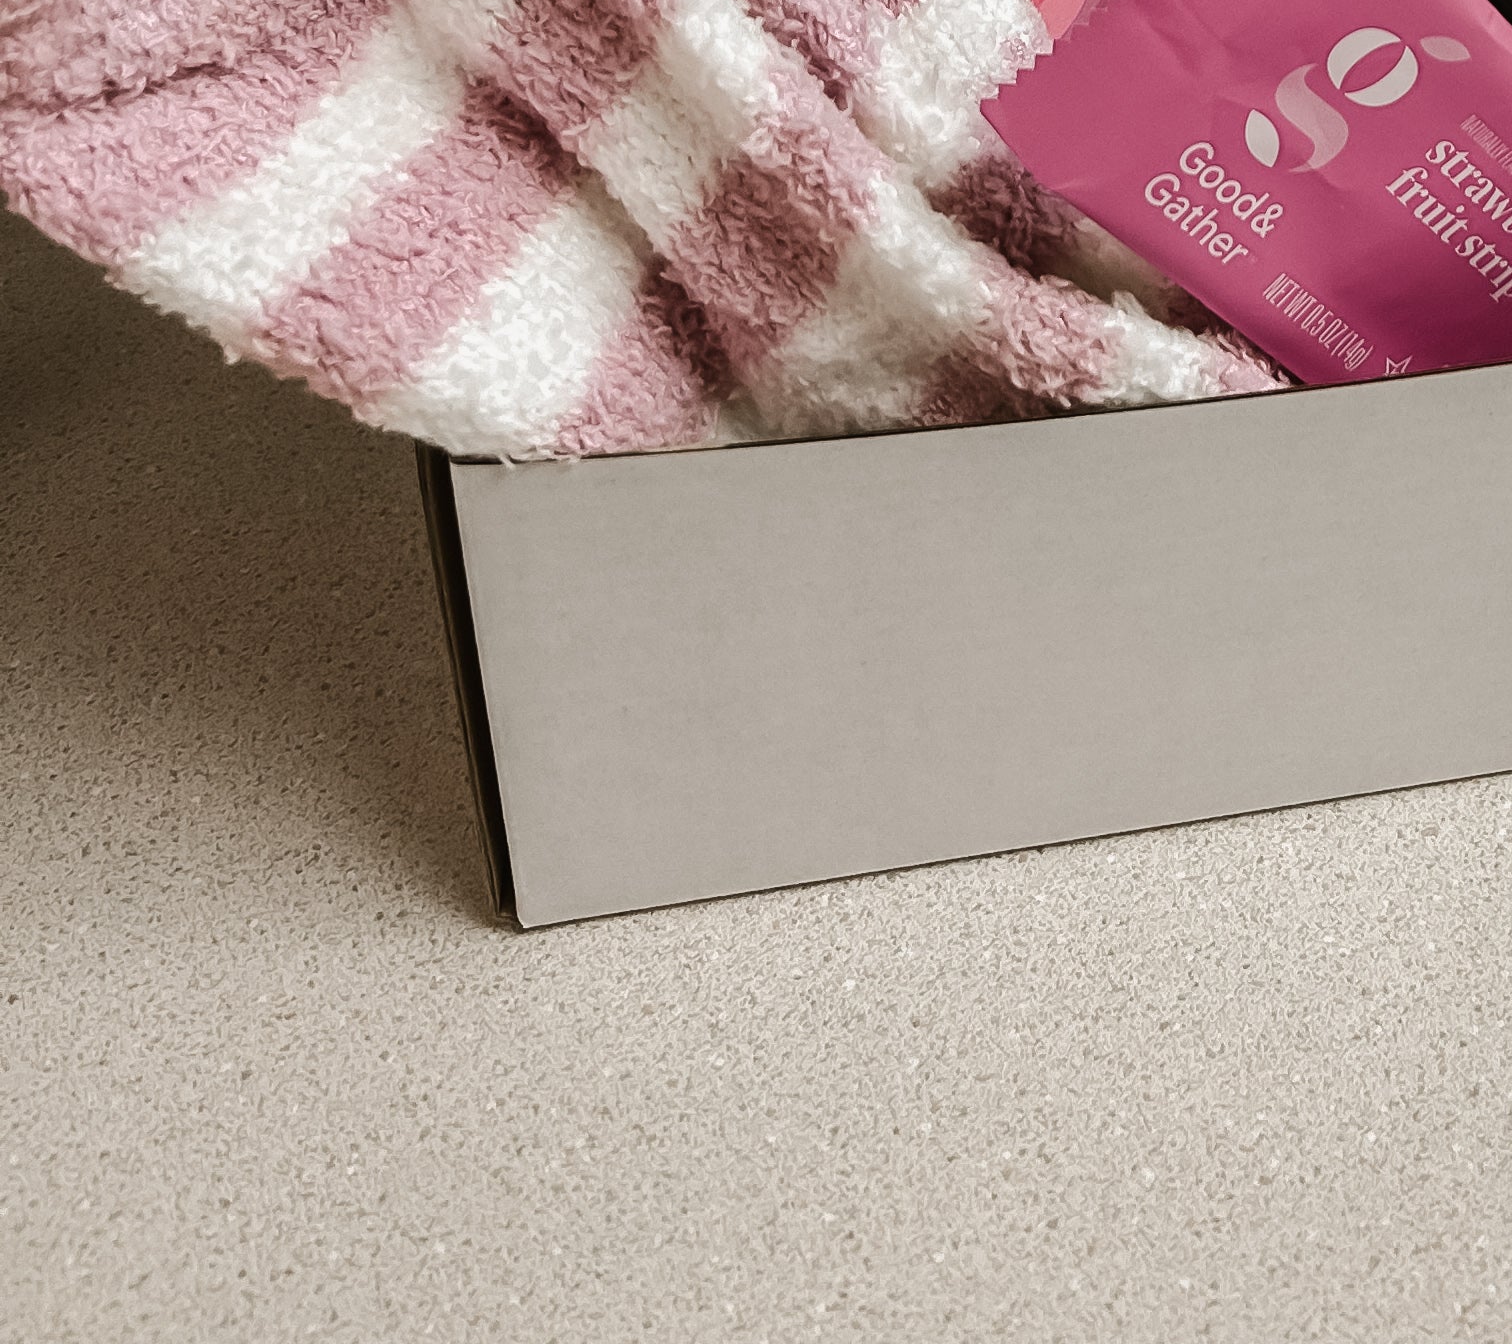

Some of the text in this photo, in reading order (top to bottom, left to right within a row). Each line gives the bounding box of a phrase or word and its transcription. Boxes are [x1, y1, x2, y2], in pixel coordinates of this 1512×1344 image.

[1144, 173, 1249, 264] Gather
[1385, 167, 1469, 243] fruit
[1262, 272, 1300, 308] NET
[1284, 288, 1317, 322] WT
[1319, 318, 1349, 349] OZ
